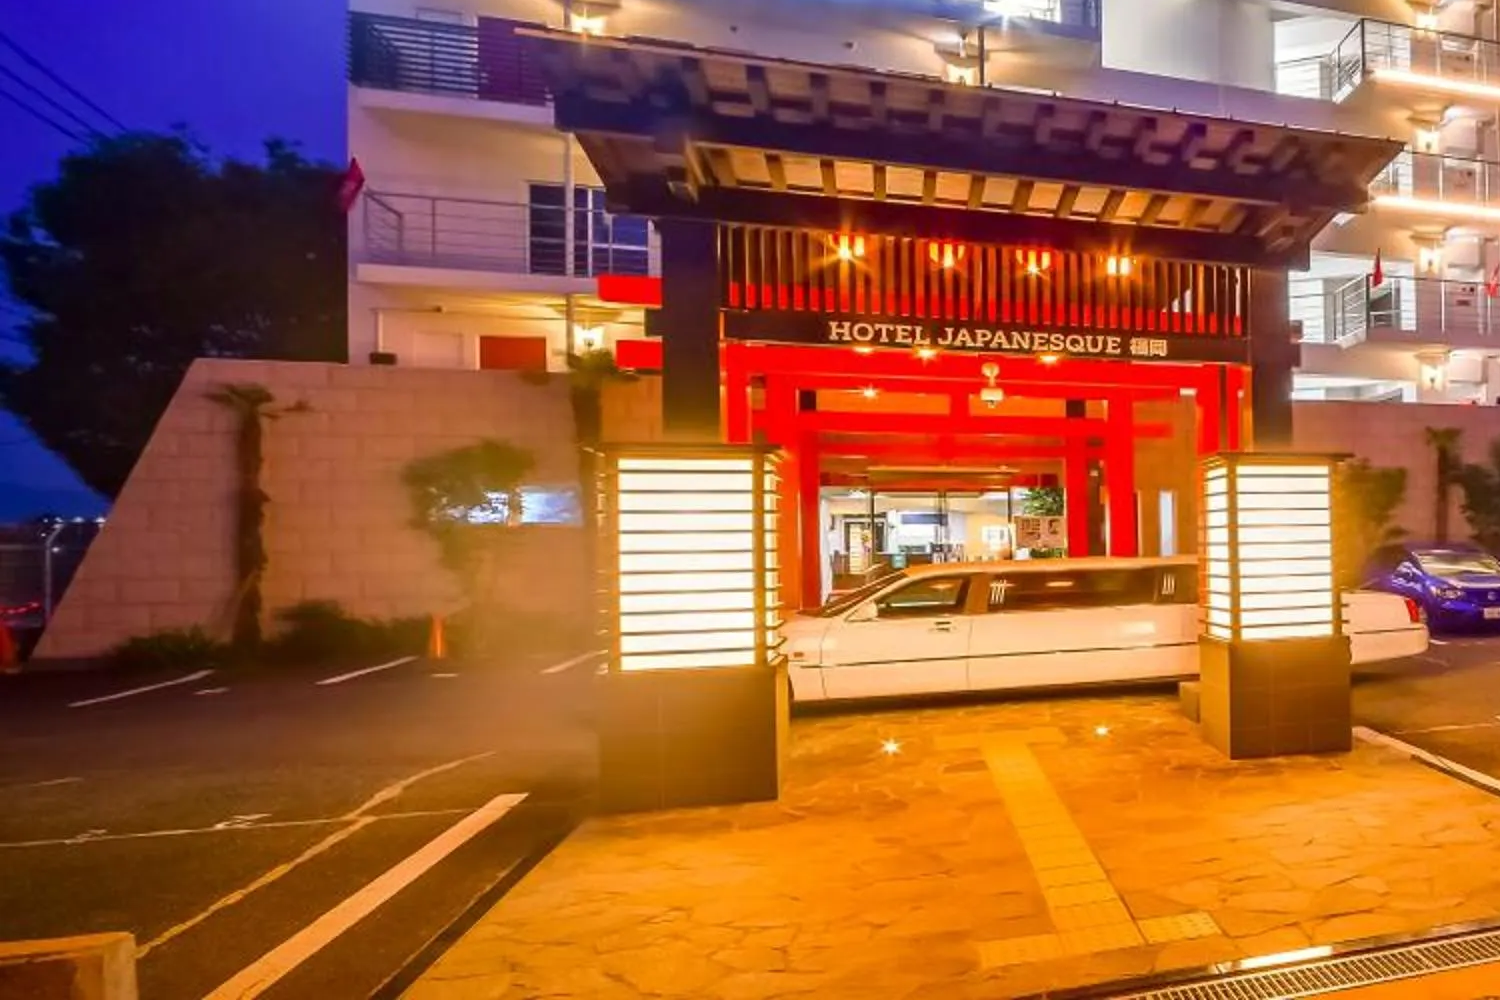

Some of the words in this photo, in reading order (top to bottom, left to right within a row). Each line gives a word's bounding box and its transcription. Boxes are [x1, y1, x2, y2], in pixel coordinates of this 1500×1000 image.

[829, 321, 930, 345] HOTEL
[938, 327, 1121, 354] JAPANESQUE
[1130, 336, 1167, 356] 福岡
